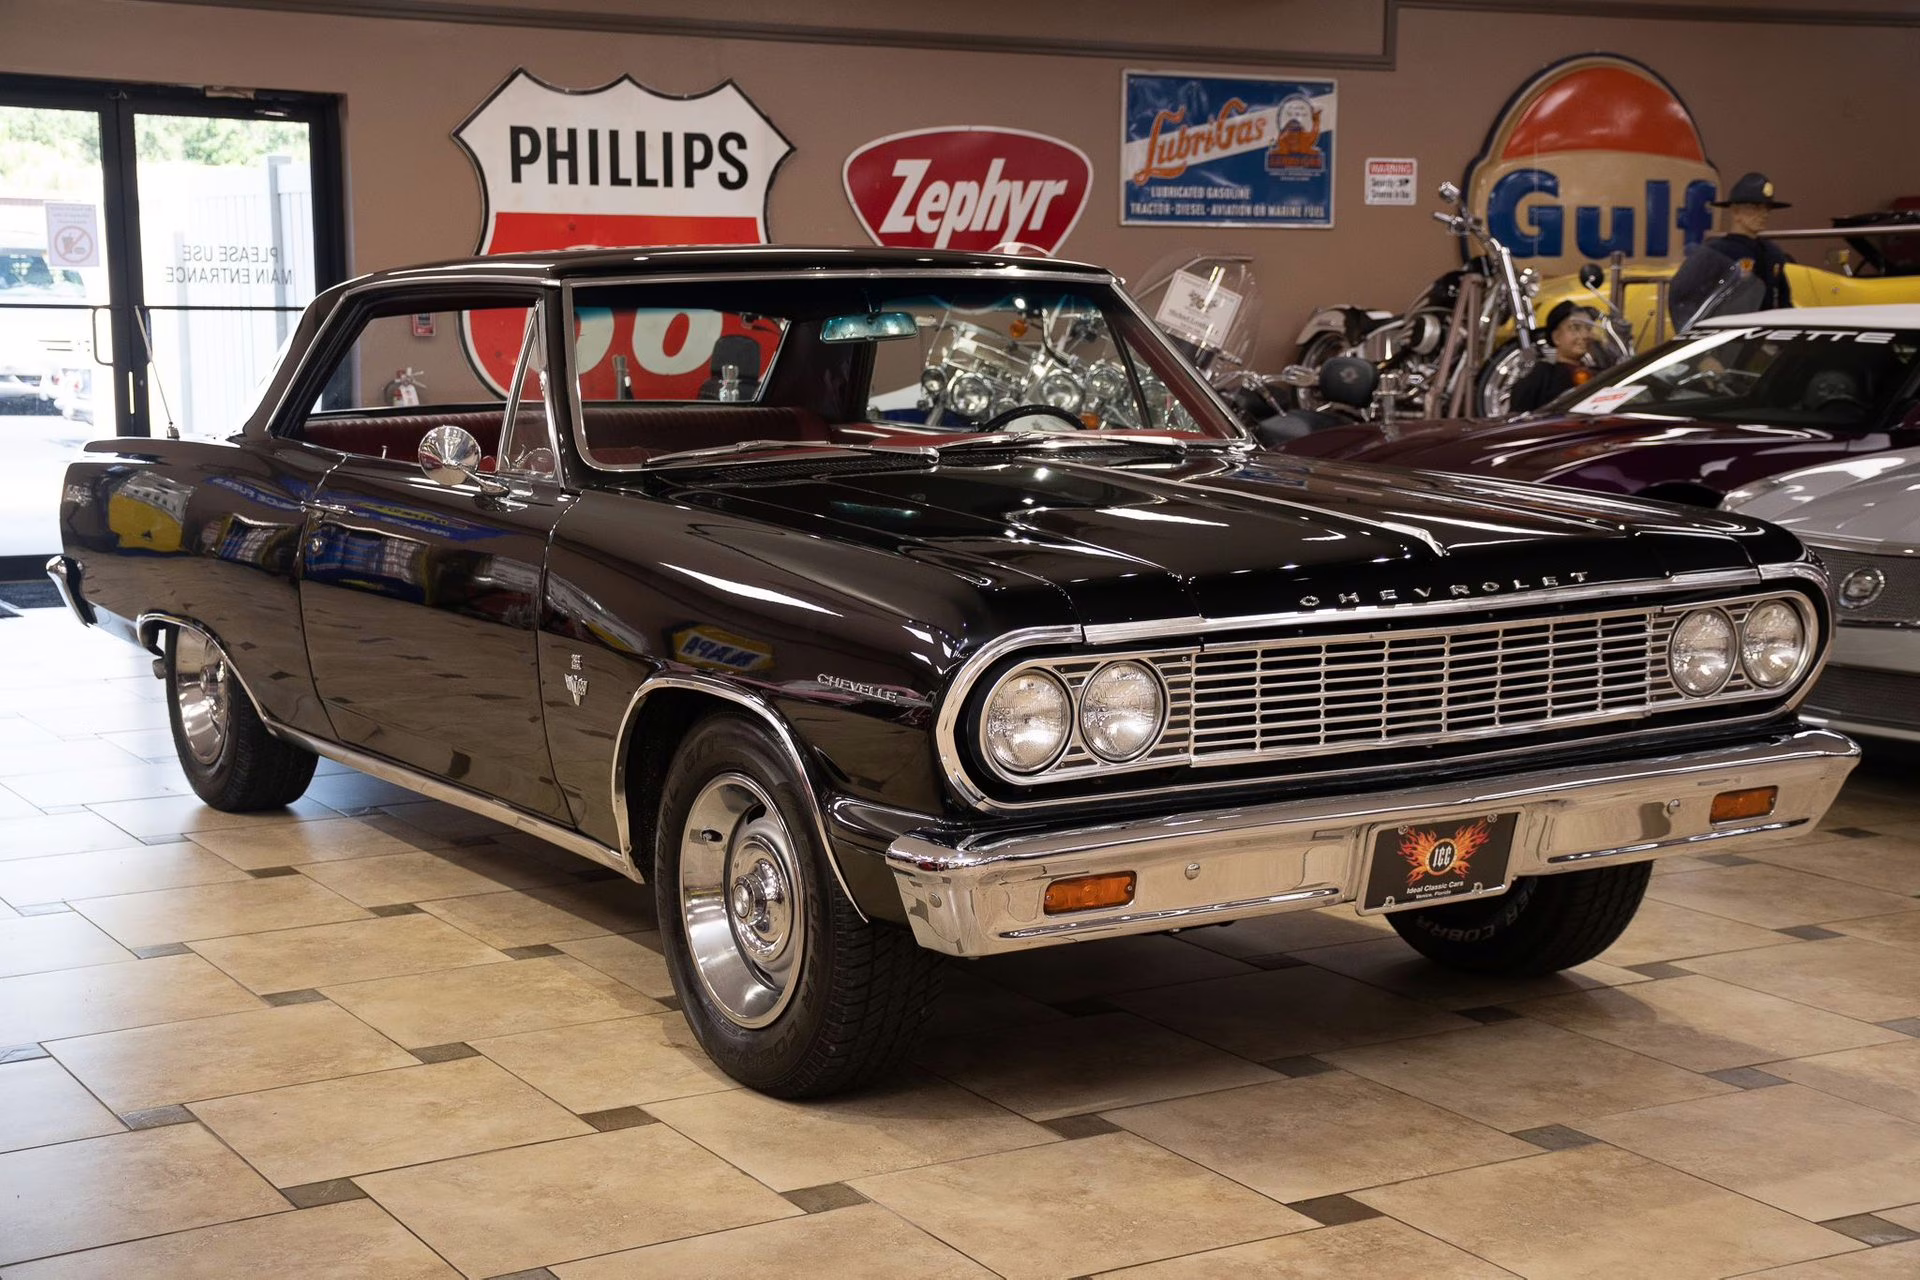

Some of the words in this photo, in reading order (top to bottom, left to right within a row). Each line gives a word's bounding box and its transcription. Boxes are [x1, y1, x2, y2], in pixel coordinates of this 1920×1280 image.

[510, 125, 748, 190] PHILLIPS
[878, 158, 1069, 254] Zephyr
[1150, 186, 1205, 199] LUBRICATED
[1206, 186, 1251, 199] GASOLINE
[1487, 168, 1717, 259] Gulf
[1300, 571, 1588, 606] CHEVROLET
[817, 673, 897, 703] CHEVELLE
[1407, 885, 1424, 895] Ideal
[1424, 883, 1448, 892] Classic
[1448, 880, 1464, 889] Cars
